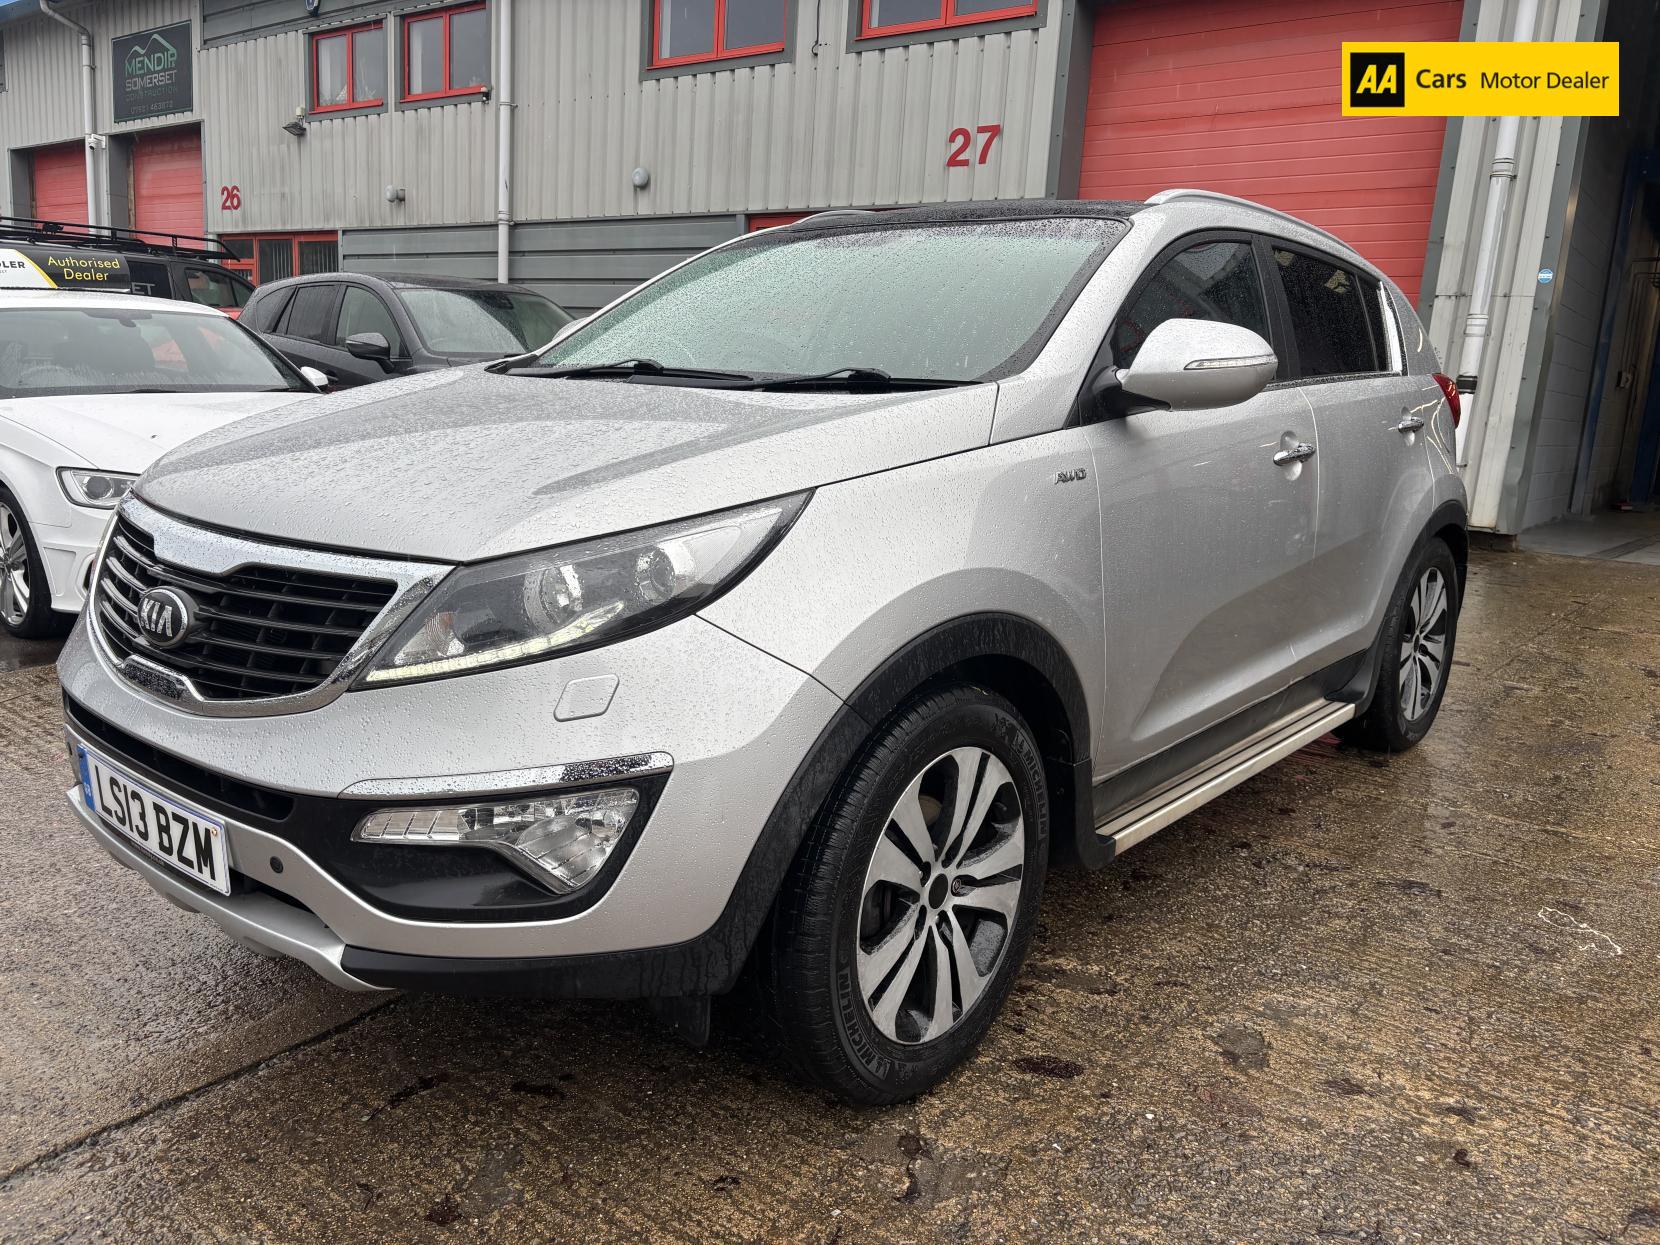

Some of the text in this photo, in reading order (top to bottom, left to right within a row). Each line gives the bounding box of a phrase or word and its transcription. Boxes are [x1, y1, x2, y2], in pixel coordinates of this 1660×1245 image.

[125, 69, 177, 92] SOMERSET
[946, 124, 1001, 167] 27
[221, 185, 241, 210] 26
[48, 256, 120, 269] Authorised
[64, 268, 109, 281] Dealer
[141, 598, 173, 637] KIA
[153, 801, 216, 881] BZM
